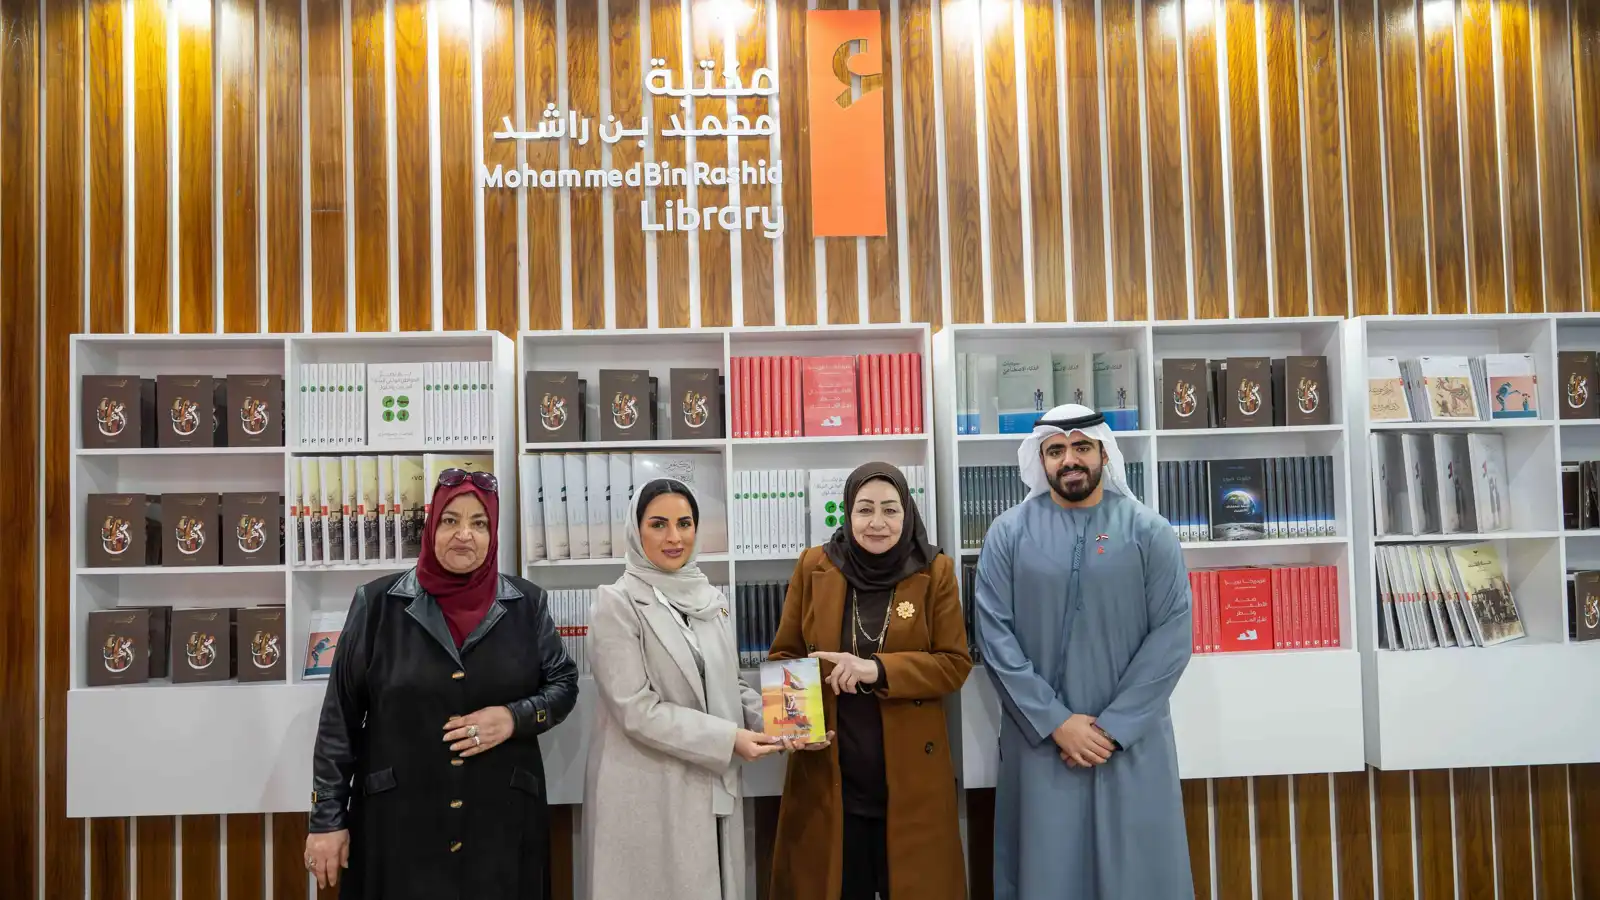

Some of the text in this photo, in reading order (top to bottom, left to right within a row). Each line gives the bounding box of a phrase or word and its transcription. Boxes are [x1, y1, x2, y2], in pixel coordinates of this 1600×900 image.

[644, 57, 779, 97] مكتبة
[493, 102, 778, 148] محمد بن راشد
[480, 159, 783, 189] Mohammed Bin Rashid
[641, 200, 785, 239] Library
